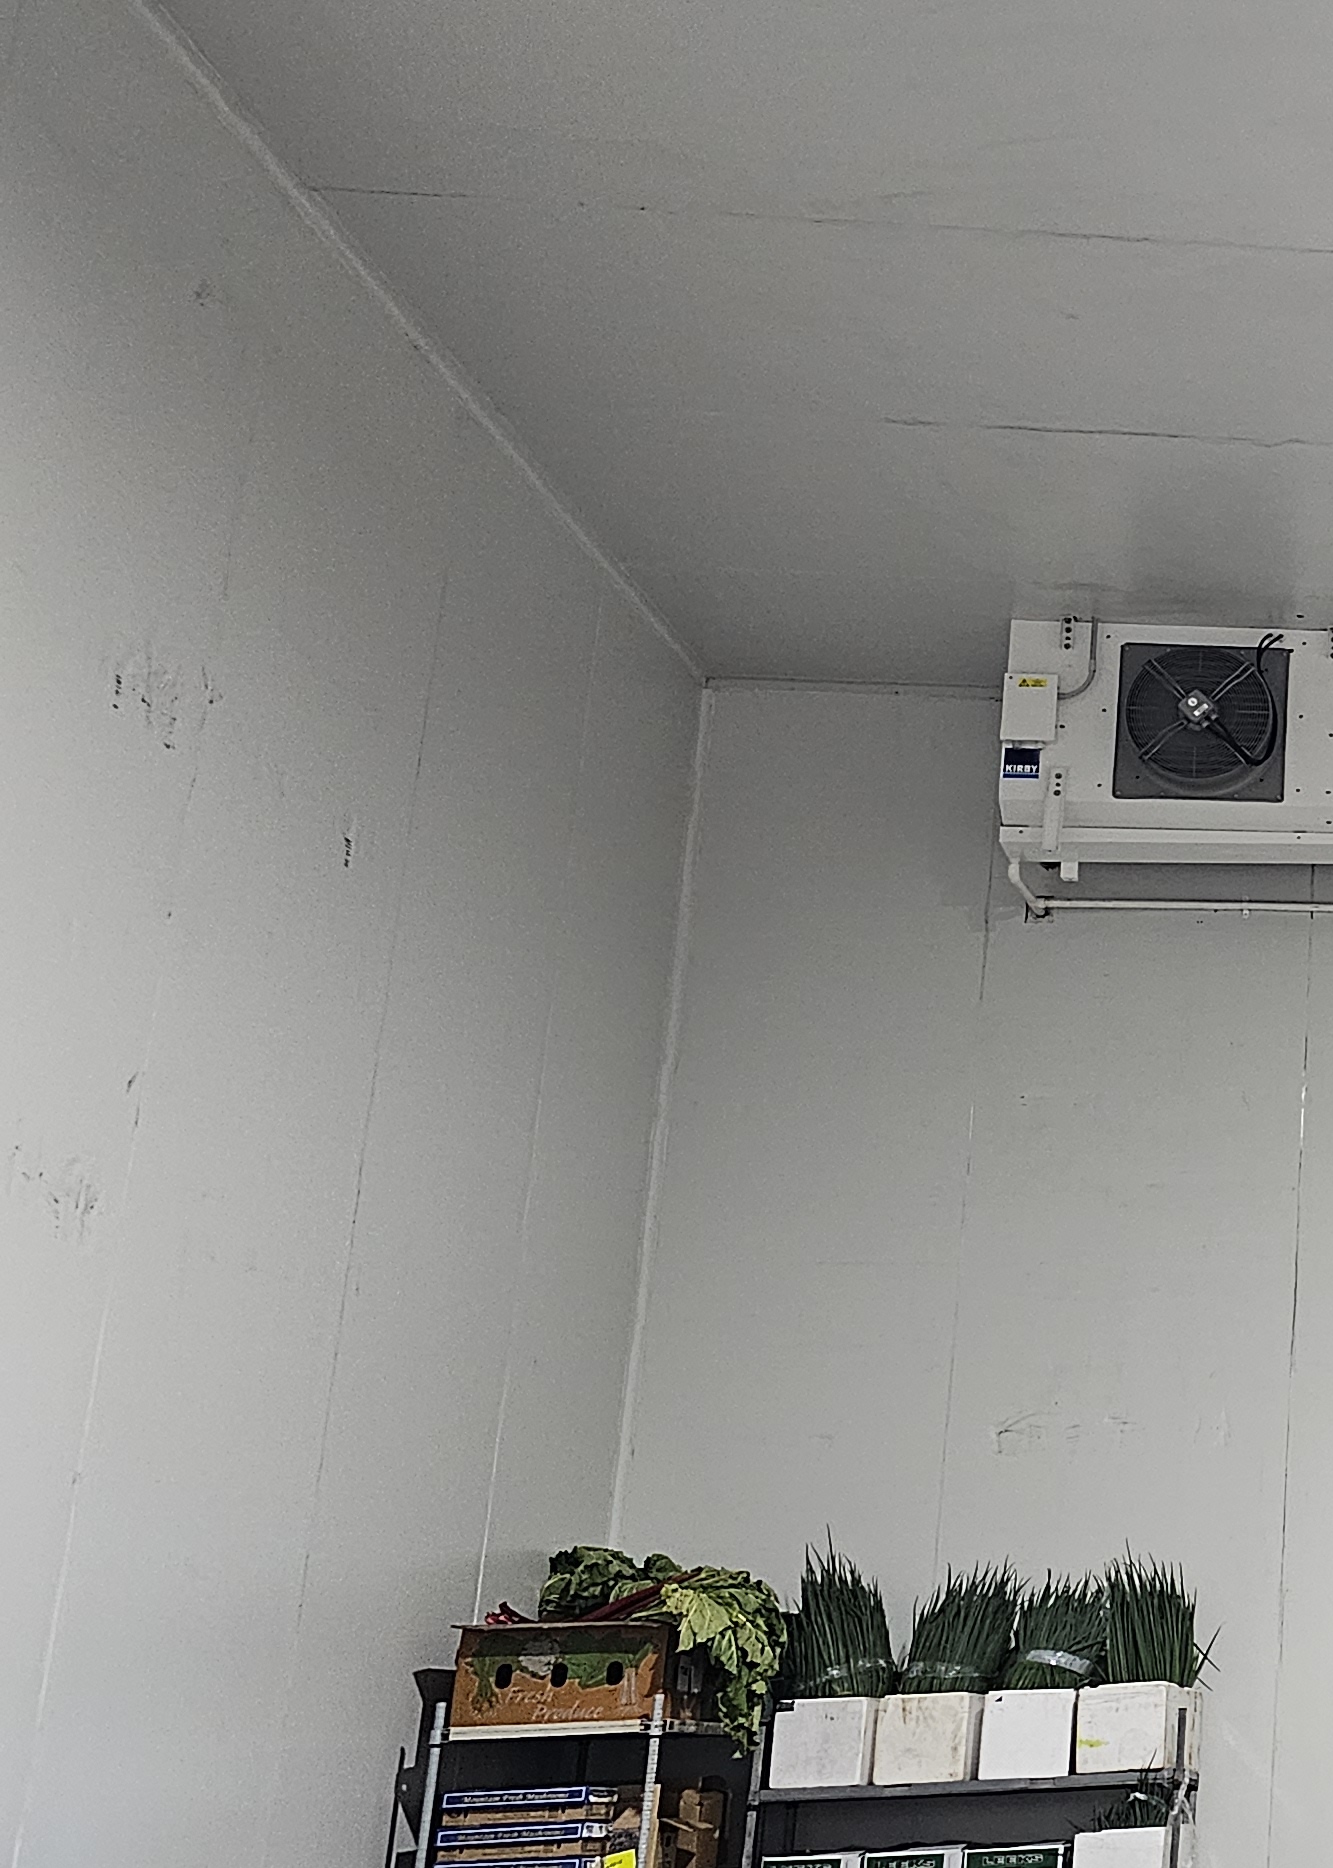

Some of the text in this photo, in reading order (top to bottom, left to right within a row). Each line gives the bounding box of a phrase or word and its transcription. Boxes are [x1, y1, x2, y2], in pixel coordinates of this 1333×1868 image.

[1005, 764, 1038, 773] KIRBY
[506, 1684, 555, 1703] Fresh
[531, 1705, 604, 1720] Produce
[982, 1854, 1043, 1866] LEEKS
